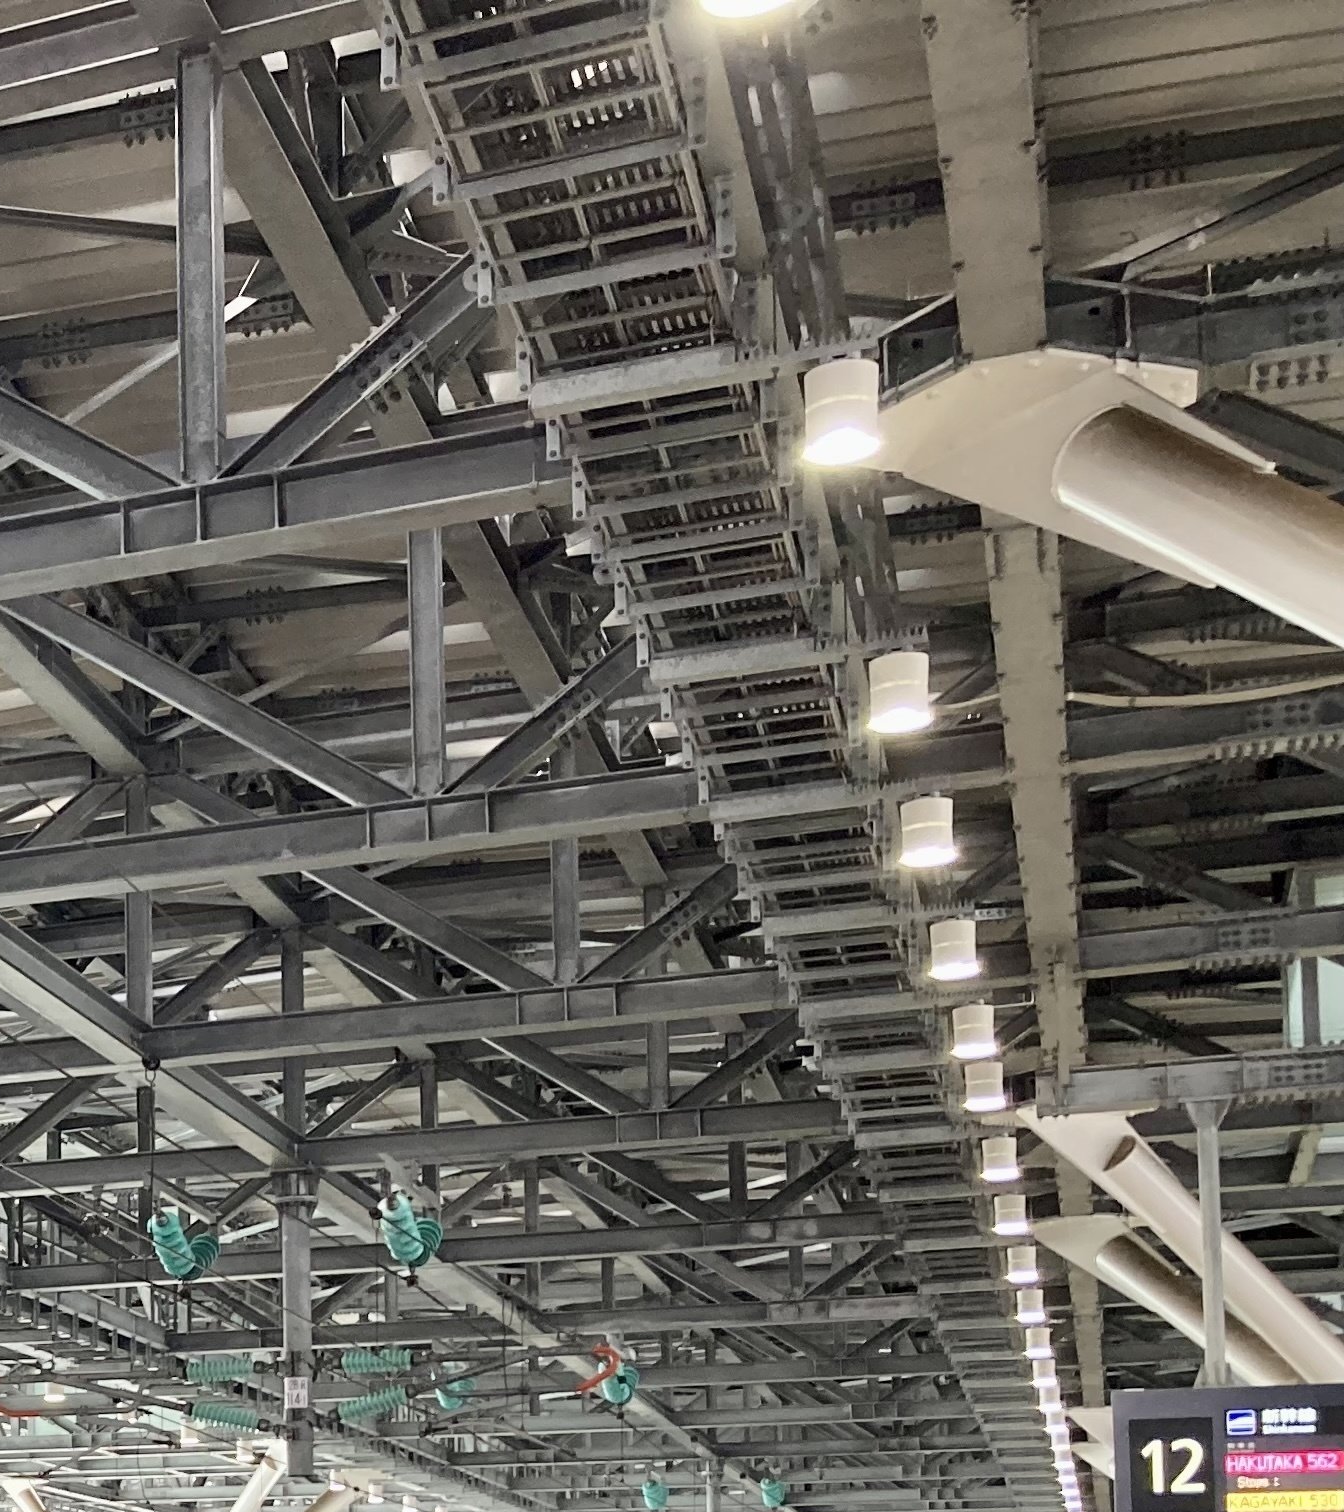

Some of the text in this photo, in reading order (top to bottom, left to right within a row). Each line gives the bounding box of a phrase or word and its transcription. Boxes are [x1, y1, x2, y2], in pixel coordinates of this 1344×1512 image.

[1140, 1437, 1206, 1495] 12
[1226, 1453, 1339, 1472] HAKUTAKA 562
[1228, 1494, 1338, 1509] KAGAYAKI 530
